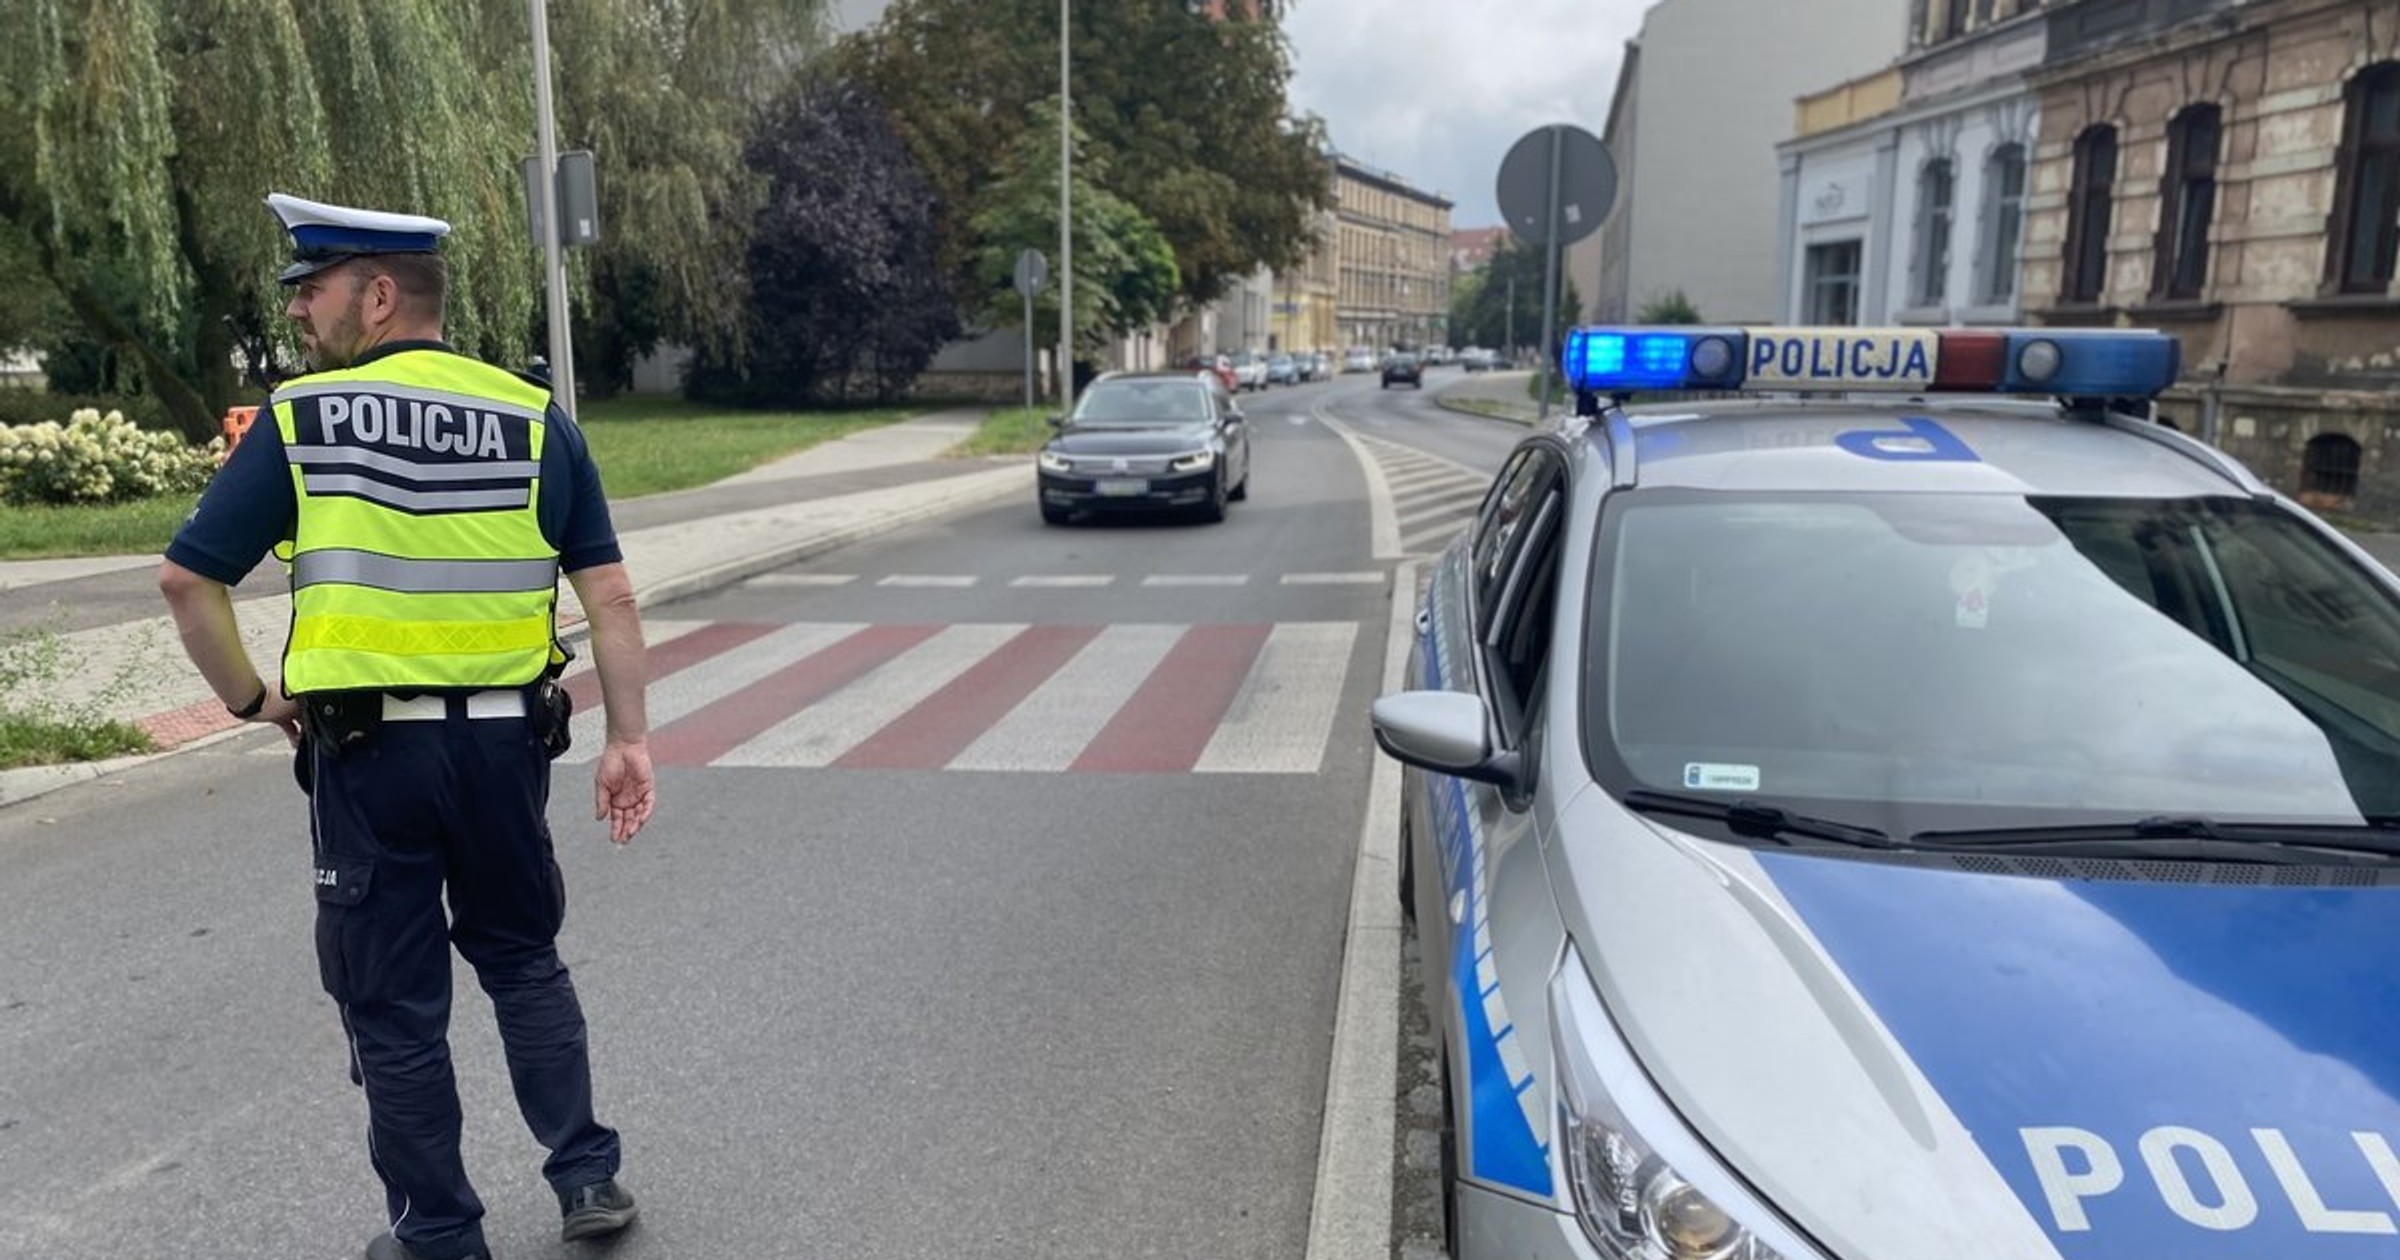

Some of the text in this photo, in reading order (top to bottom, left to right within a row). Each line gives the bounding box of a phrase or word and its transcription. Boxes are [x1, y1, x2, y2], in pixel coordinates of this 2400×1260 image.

[1753, 338, 1928, 379] POLICJA
[318, 394, 508, 460] POLICJA
[2018, 1125, 2400, 1235] POLI
